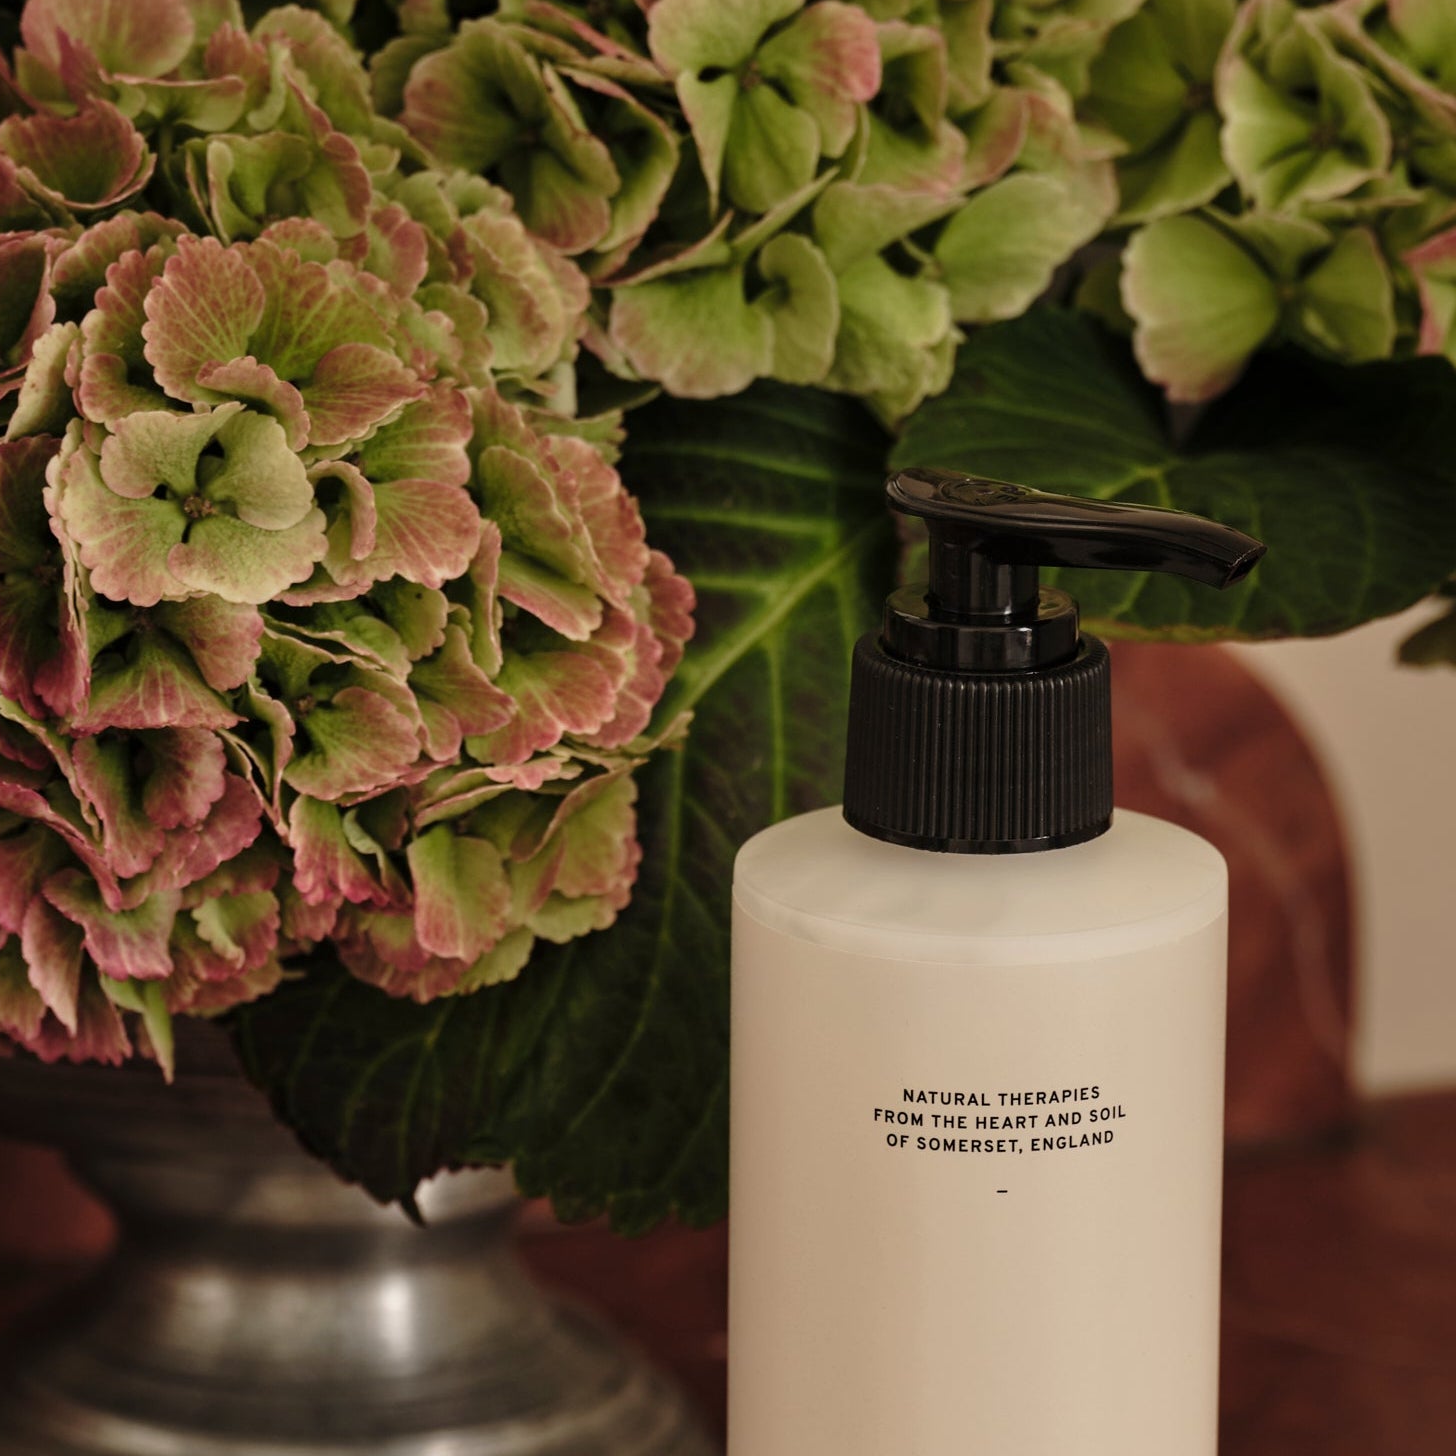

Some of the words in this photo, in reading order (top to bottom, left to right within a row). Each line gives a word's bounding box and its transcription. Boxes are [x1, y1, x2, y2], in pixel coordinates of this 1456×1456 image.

[903, 1088, 990, 1107] NATURAL
[998, 1086, 1101, 1106] THERAPIES
[874, 1108, 924, 1127] FROM
[931, 1115, 967, 1129] THE
[976, 1115, 1038, 1129] HEART
[1045, 1111, 1082, 1127] AND
[1089, 1105, 1126, 1123] SOIL
[886, 1134, 909, 1148] OF
[917, 1136, 1023, 1154] SOMERSET,
[1031, 1130, 1114, 1152] ENGLAND
